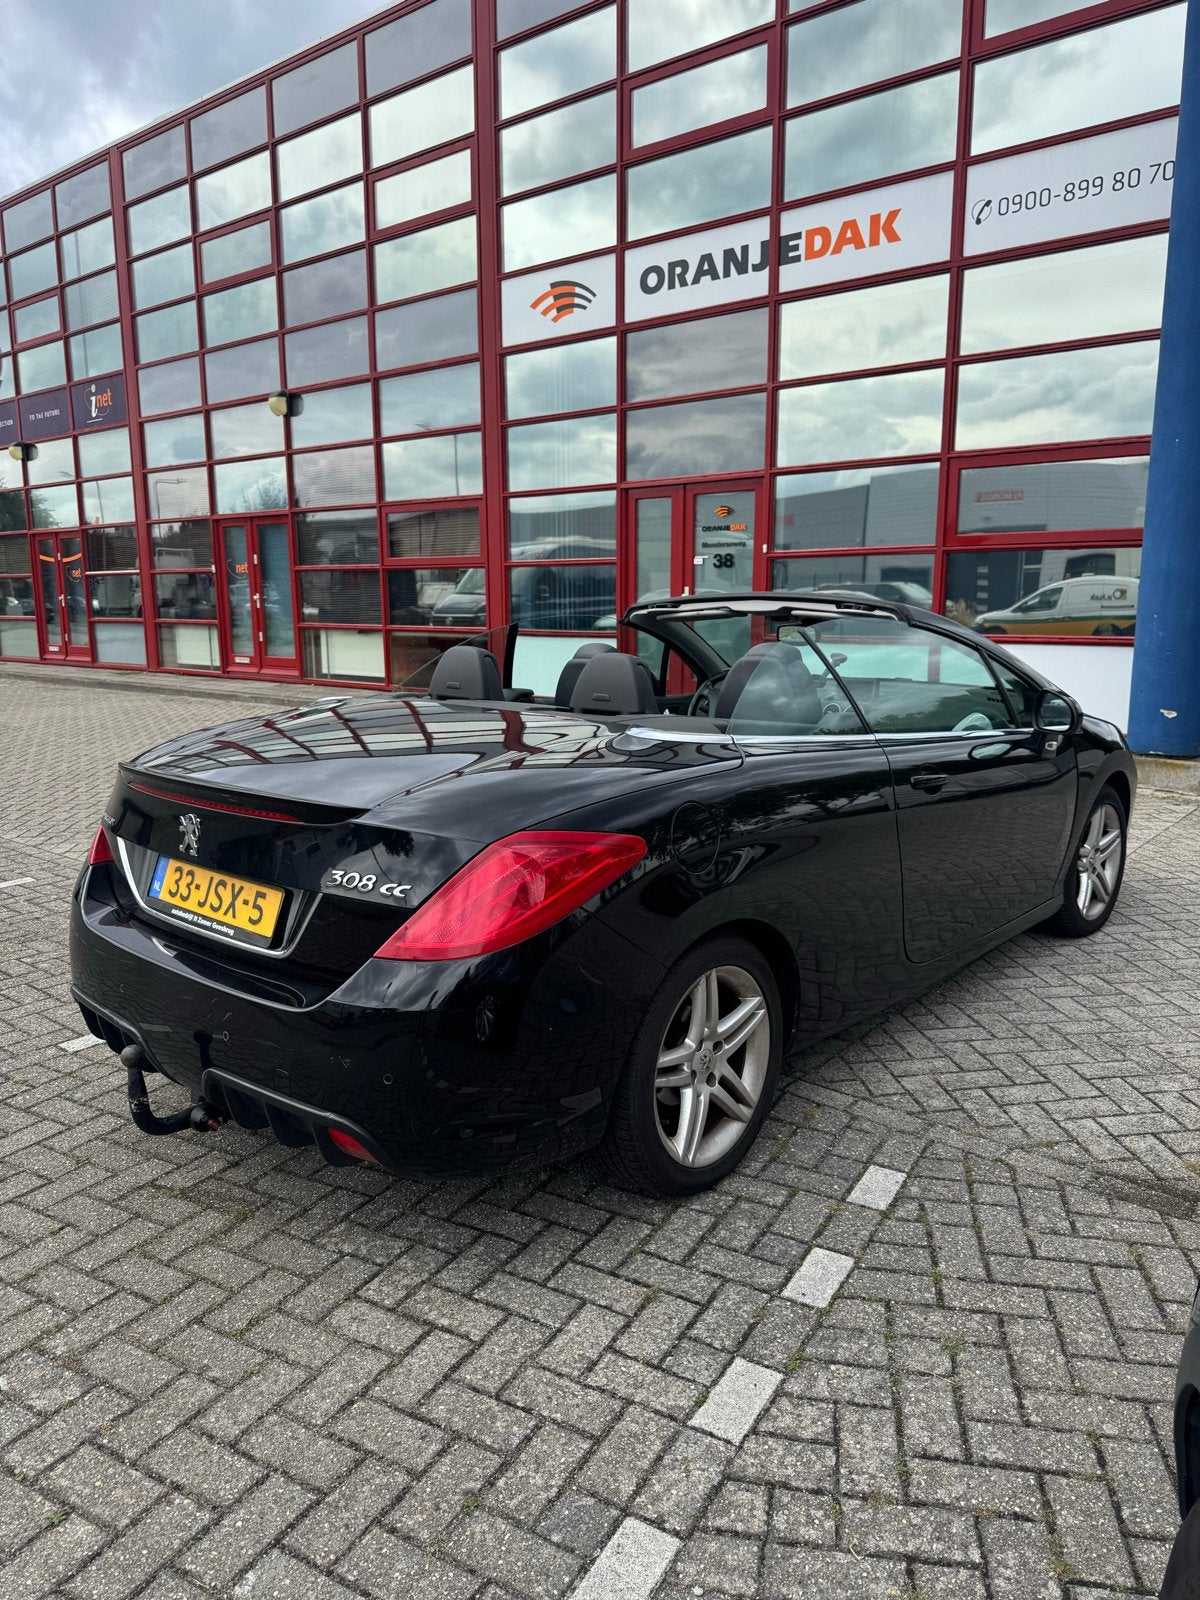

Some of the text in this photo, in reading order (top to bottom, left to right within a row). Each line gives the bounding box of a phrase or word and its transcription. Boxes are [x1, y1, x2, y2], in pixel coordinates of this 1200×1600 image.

[998, 160, 1176, 216] 0900-899 80 70
[639, 208, 902, 296] ORANJEDAK
[44, 409, 60, 418] FUTURE
[702, 523, 747, 532] ORANJEDAK
[712, 553, 734, 569] 38
[153, 880, 161, 891] NL
[325, 869, 377, 893] 308
[168, 866, 267, 925] 33-JSX-5
